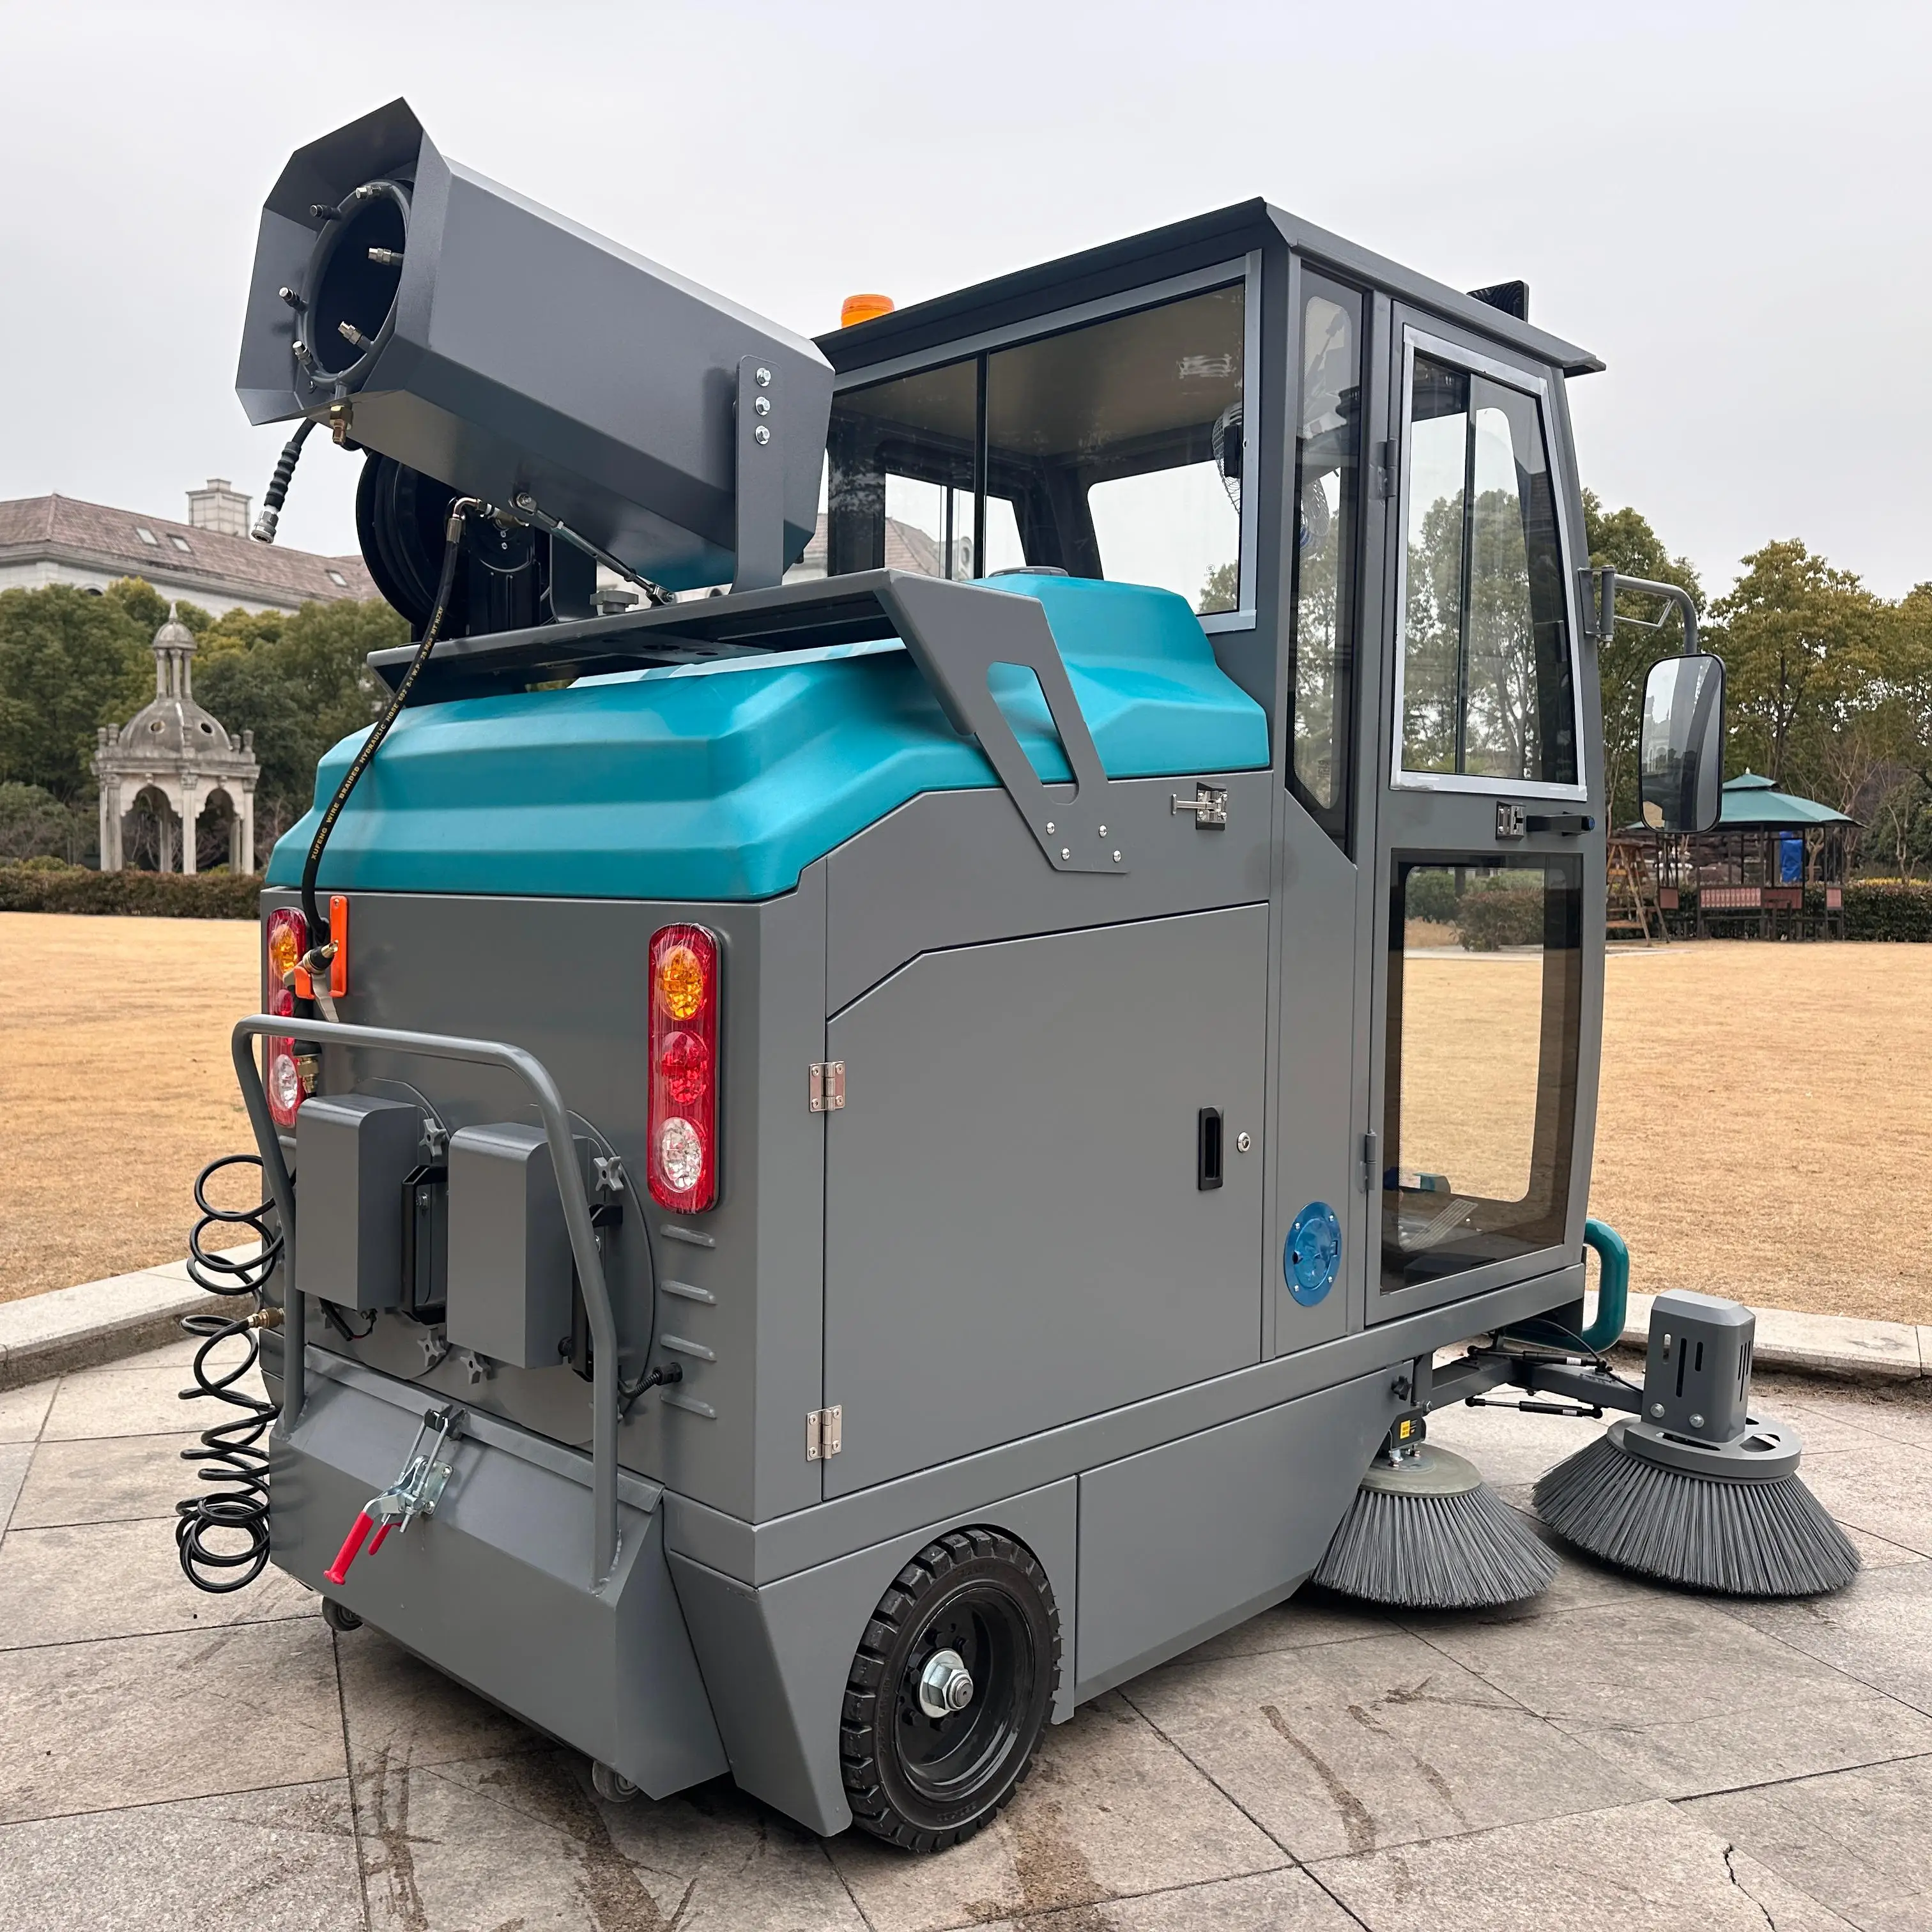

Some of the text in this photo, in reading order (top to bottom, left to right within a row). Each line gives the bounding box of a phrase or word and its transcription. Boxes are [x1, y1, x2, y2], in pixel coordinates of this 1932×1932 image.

[311, 827, 327, 860] XUFENG
[326, 802, 340, 823] WIRE
[338, 766, 360, 799] BRAIDED
[359, 723, 387, 763] HYDRAULIC
[385, 703, 399, 721] HOSE
